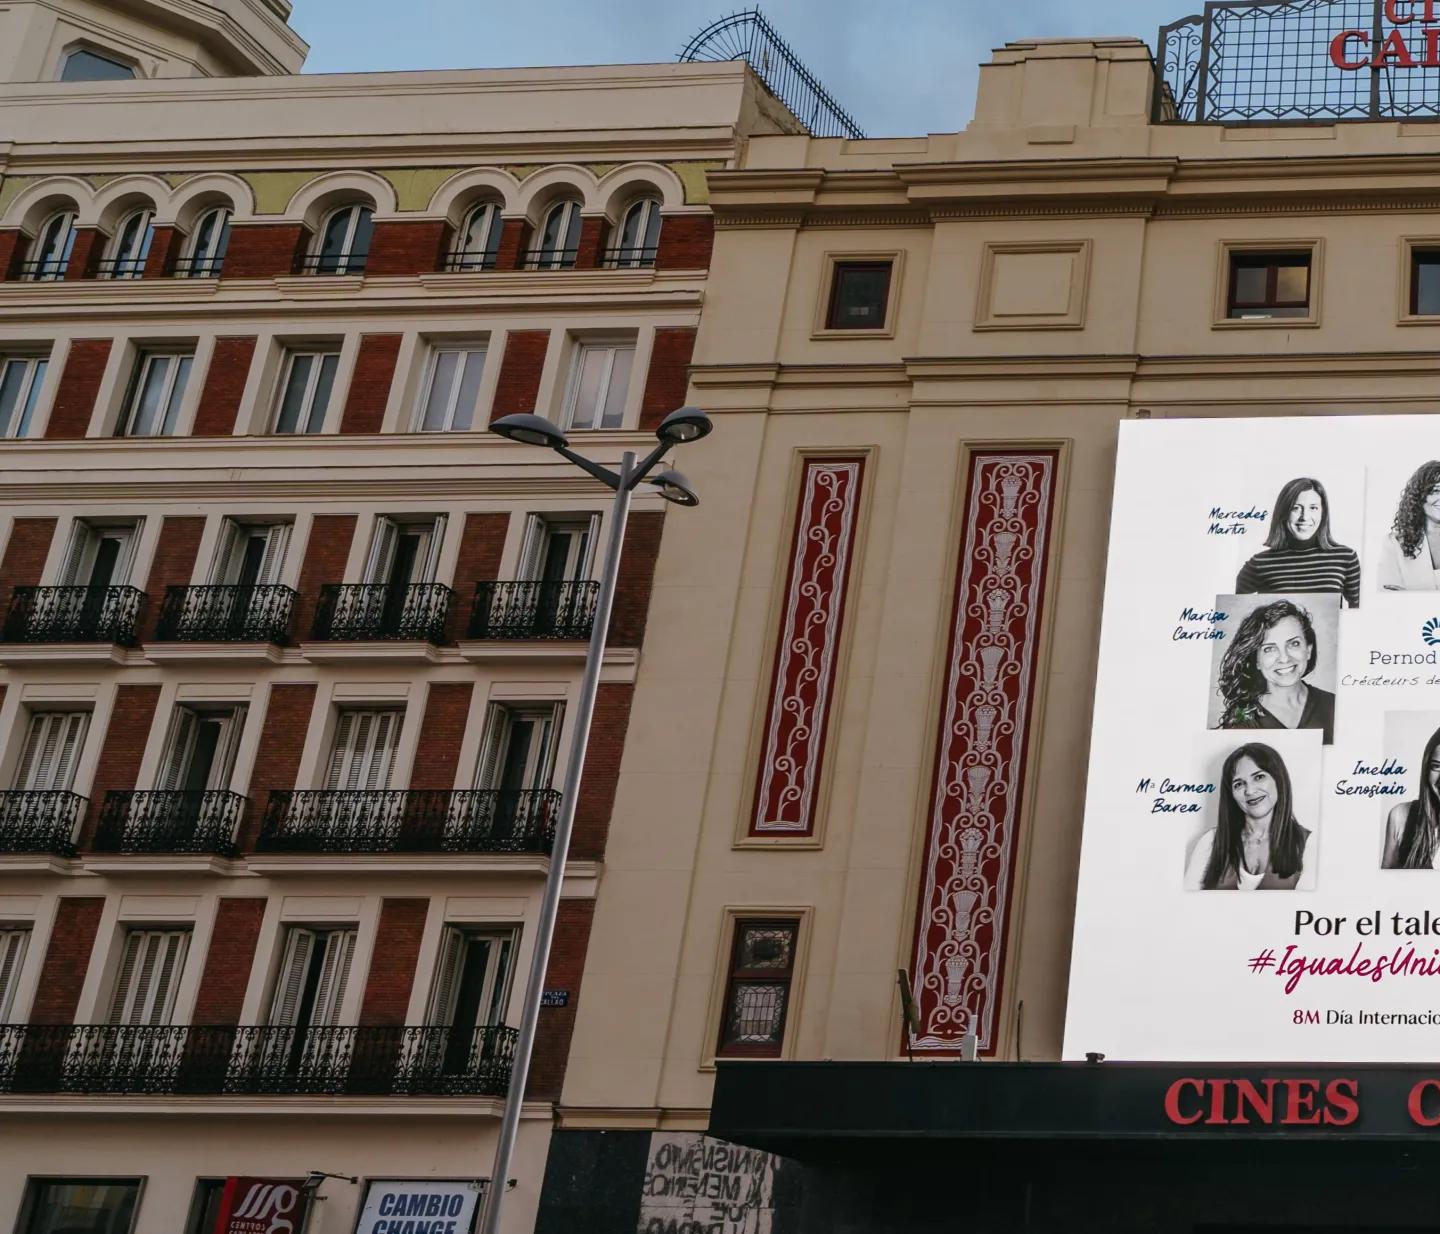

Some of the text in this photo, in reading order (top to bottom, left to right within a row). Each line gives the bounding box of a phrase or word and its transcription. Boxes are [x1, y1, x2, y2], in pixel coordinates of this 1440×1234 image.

[1209, 505, 1268, 521] Mercedes
[1180, 608, 1229, 624] Marisa
[1173, 626, 1226, 641] Carrión
[1370, 651, 1437, 665] Pernod
[1342, 675, 1418, 686] Créateurs
[1353, 759, 1407, 775] Imelda
[1160, 778, 1216, 794] Carmen
[1335, 780, 1407, 798] Senosiain
[1151, 798, 1201, 814] Barea
[1295, 911, 1346, 936] Por
[1356, 911, 1380, 935] el
[1293, 1010, 1320, 1025] 8M
[1327, 1010, 1353, 1025] Día
[1165, 1078, 1360, 1126] CINES
[378, 1193, 464, 1217] CAMBIO
[372, 1220, 457, 1234] CHANGE
